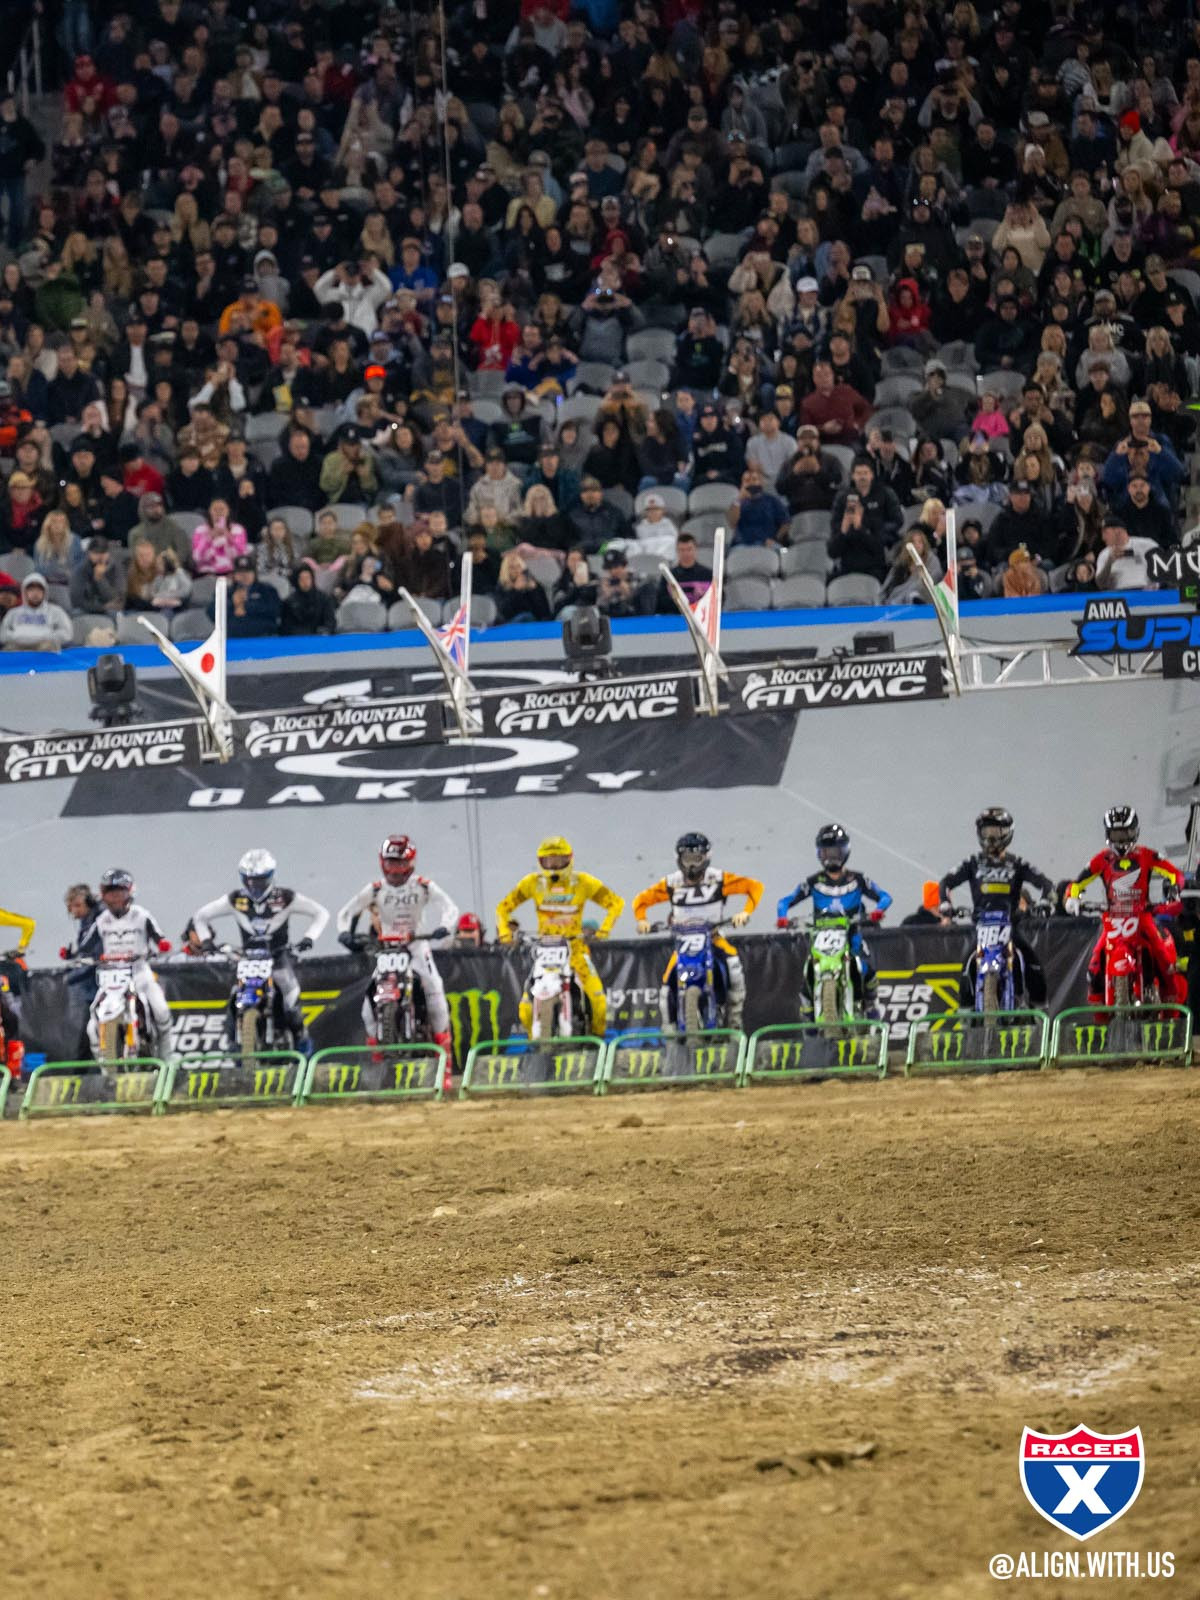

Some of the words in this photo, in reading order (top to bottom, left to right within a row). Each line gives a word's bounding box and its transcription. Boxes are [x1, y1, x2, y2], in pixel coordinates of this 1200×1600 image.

[1088, 601, 1127, 619] AMA
[770, 668, 827, 685] ROCKY
[830, 660, 927, 681] MOUNTAIN
[1182, 650, 1200, 673] C
[523, 691, 581, 709] ROCKY
[583, 680, 678, 703] MOUNTAIN
[272, 714, 329, 732] ROCKY
[331, 704, 427, 726] MOUNTAIN
[31, 739, 88, 757] ROCKY
[90, 728, 184, 750] MOUNTAIN
[188, 770, 643, 807] OAKLEY
[672, 884, 719, 904] FLY
[1107, 917, 1140, 938] 30
[680, 934, 706, 955] 79
